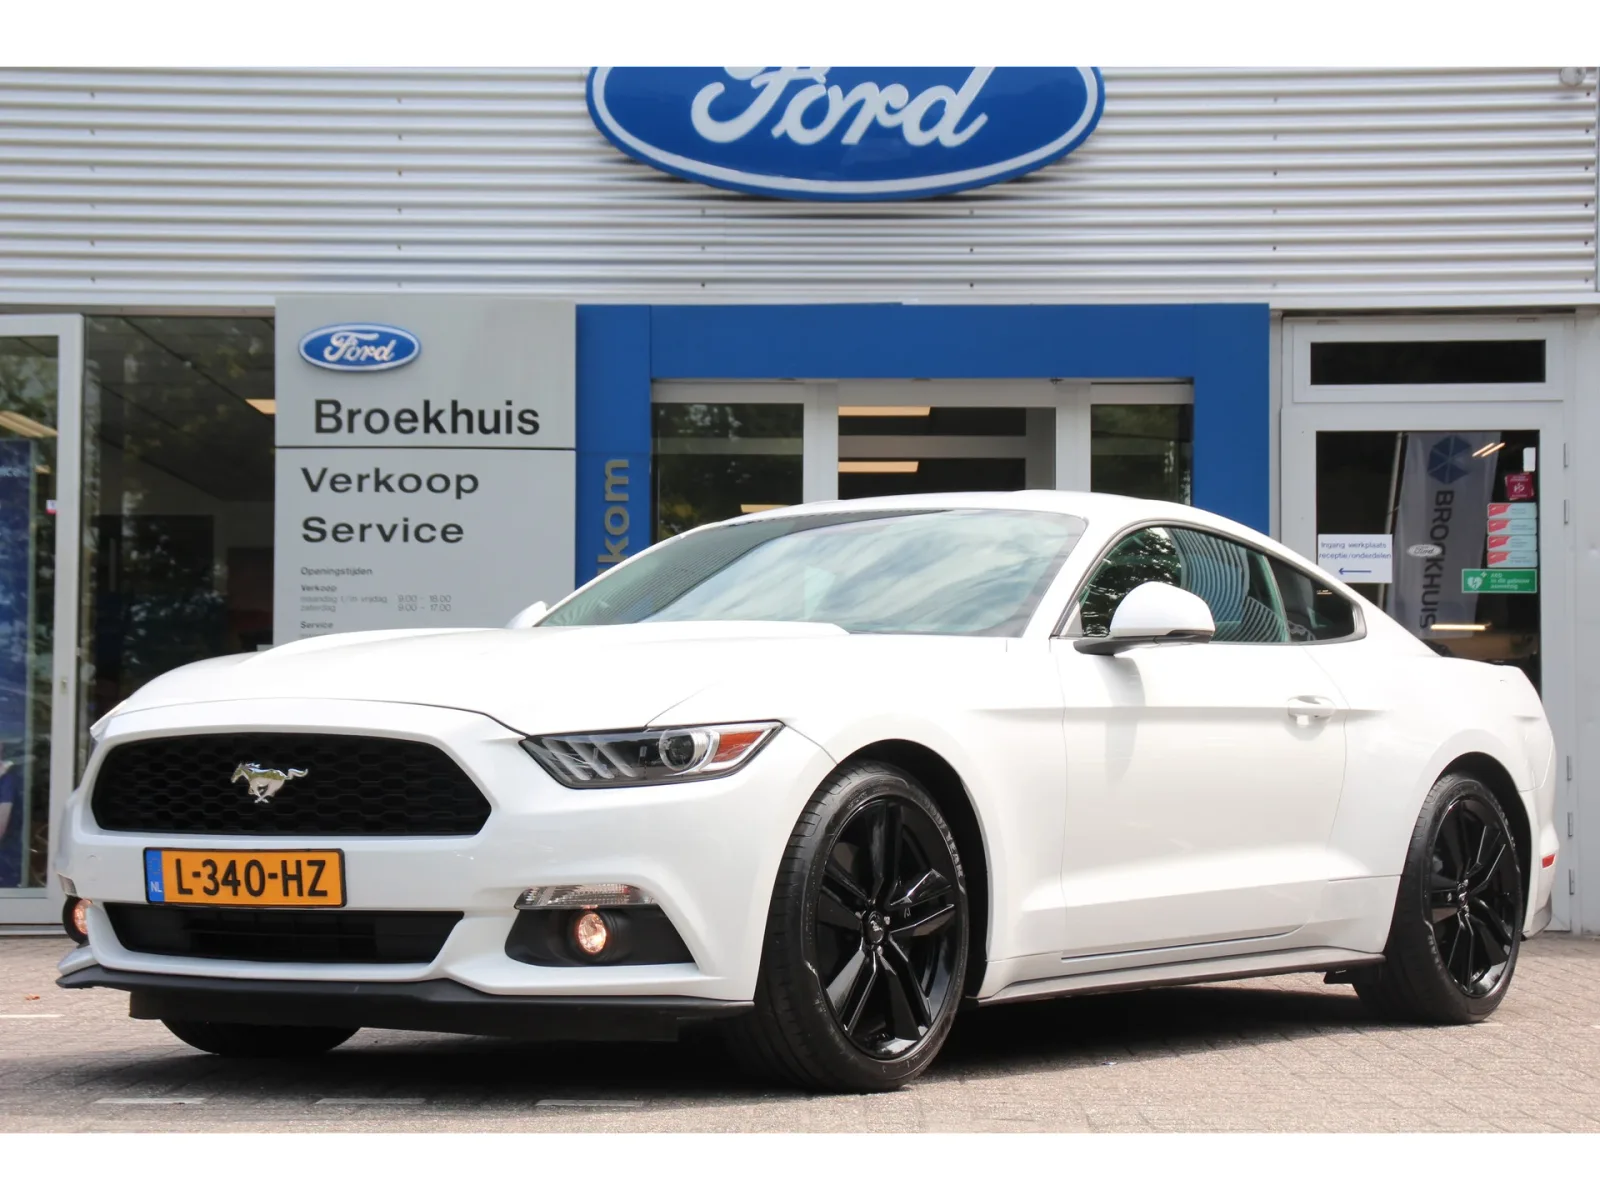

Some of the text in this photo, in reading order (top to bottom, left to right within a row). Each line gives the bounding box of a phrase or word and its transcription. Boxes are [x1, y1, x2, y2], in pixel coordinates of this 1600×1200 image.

[323, 331, 397, 362] Ford
[315, 399, 541, 435] Broekhuis
[301, 467, 479, 500] Verkoop
[301, 516, 464, 544] Service
[597, 459, 630, 575] kom
[1321, 541, 1387, 549] Ingang werkplaats
[301, 567, 373, 576] Openingstijden
[301, 621, 333, 629] Service
[150, 881, 163, 893] NL
[175, 858, 328, 897] L-340-HZ
